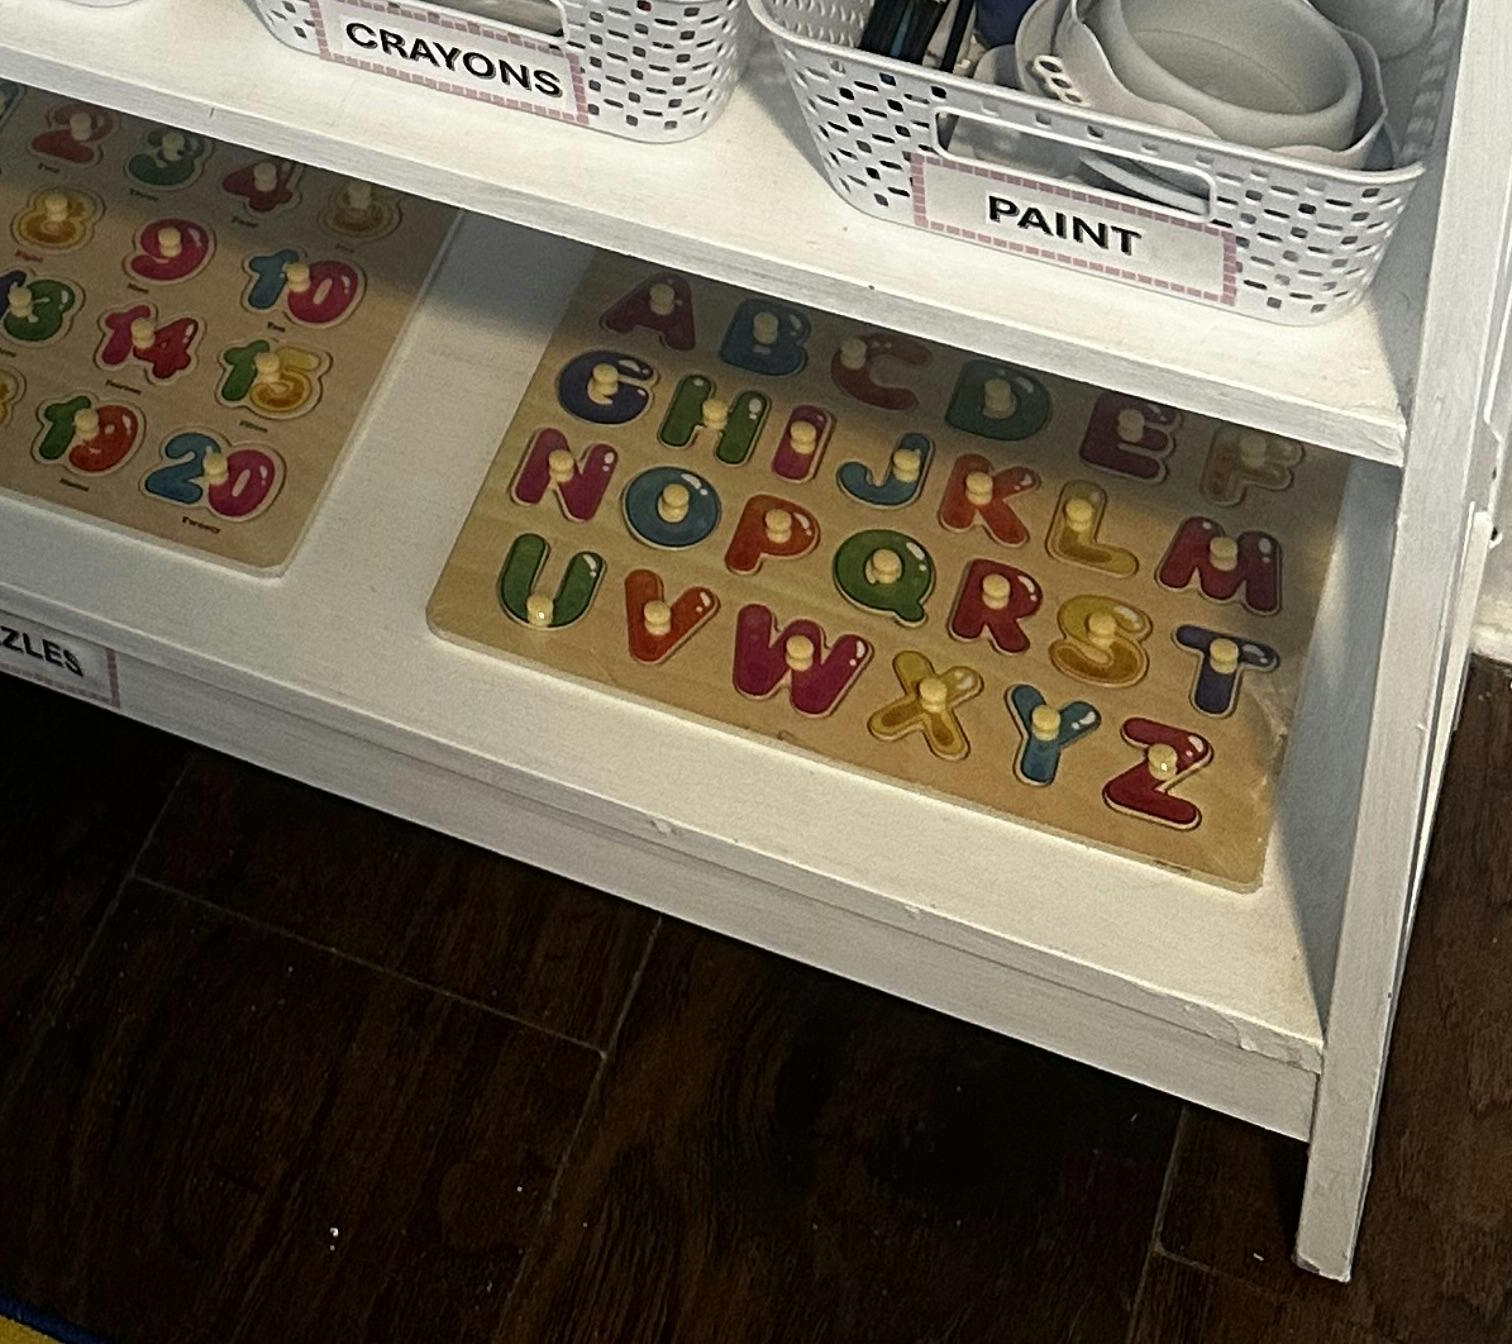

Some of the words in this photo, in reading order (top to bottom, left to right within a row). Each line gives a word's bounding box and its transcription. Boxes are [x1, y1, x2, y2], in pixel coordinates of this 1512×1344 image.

[346, 20, 564, 99] CRAYONS
[130, 219, 209, 281] 9
[248, 249, 358, 324] 10
[988, 195, 1143, 256] PAINT
[101, 304, 198, 379] 14
[221, 339, 321, 413] 15
[601, 274, 697, 351] A
[721, 300, 811, 377] B
[832, 333, 932, 411] C
[945, 359, 1052, 441] D
[1081, 391, 1179, 480] E
[39, 395, 138, 472] 19
[145, 432, 276, 517] 20
[556, 350, 653, 424] G
[657, 374, 771, 465] H
[772, 404, 832, 481] I
[838, 433, 933, 508] J
[939, 453, 1040, 546] K
[1046, 481, 1138, 577] L
[1158, 517, 1282, 615] M
[511, 428, 618, 521] N
[623, 467, 721, 548] O
[725, 494, 821, 574] P
[832, 530, 935, 626] Q
[948, 560, 1043, 655] R
[1051, 595, 1152, 688] S
[1173, 624, 1279, 715] T
[498, 534, 606, 628] U
[624, 570, 719, 664] V
[734, 605, 873, 715] W
[869, 652, 984, 759] X
[1006, 684, 1100, 787] Y
[1102, 718, 1214, 830] Z
